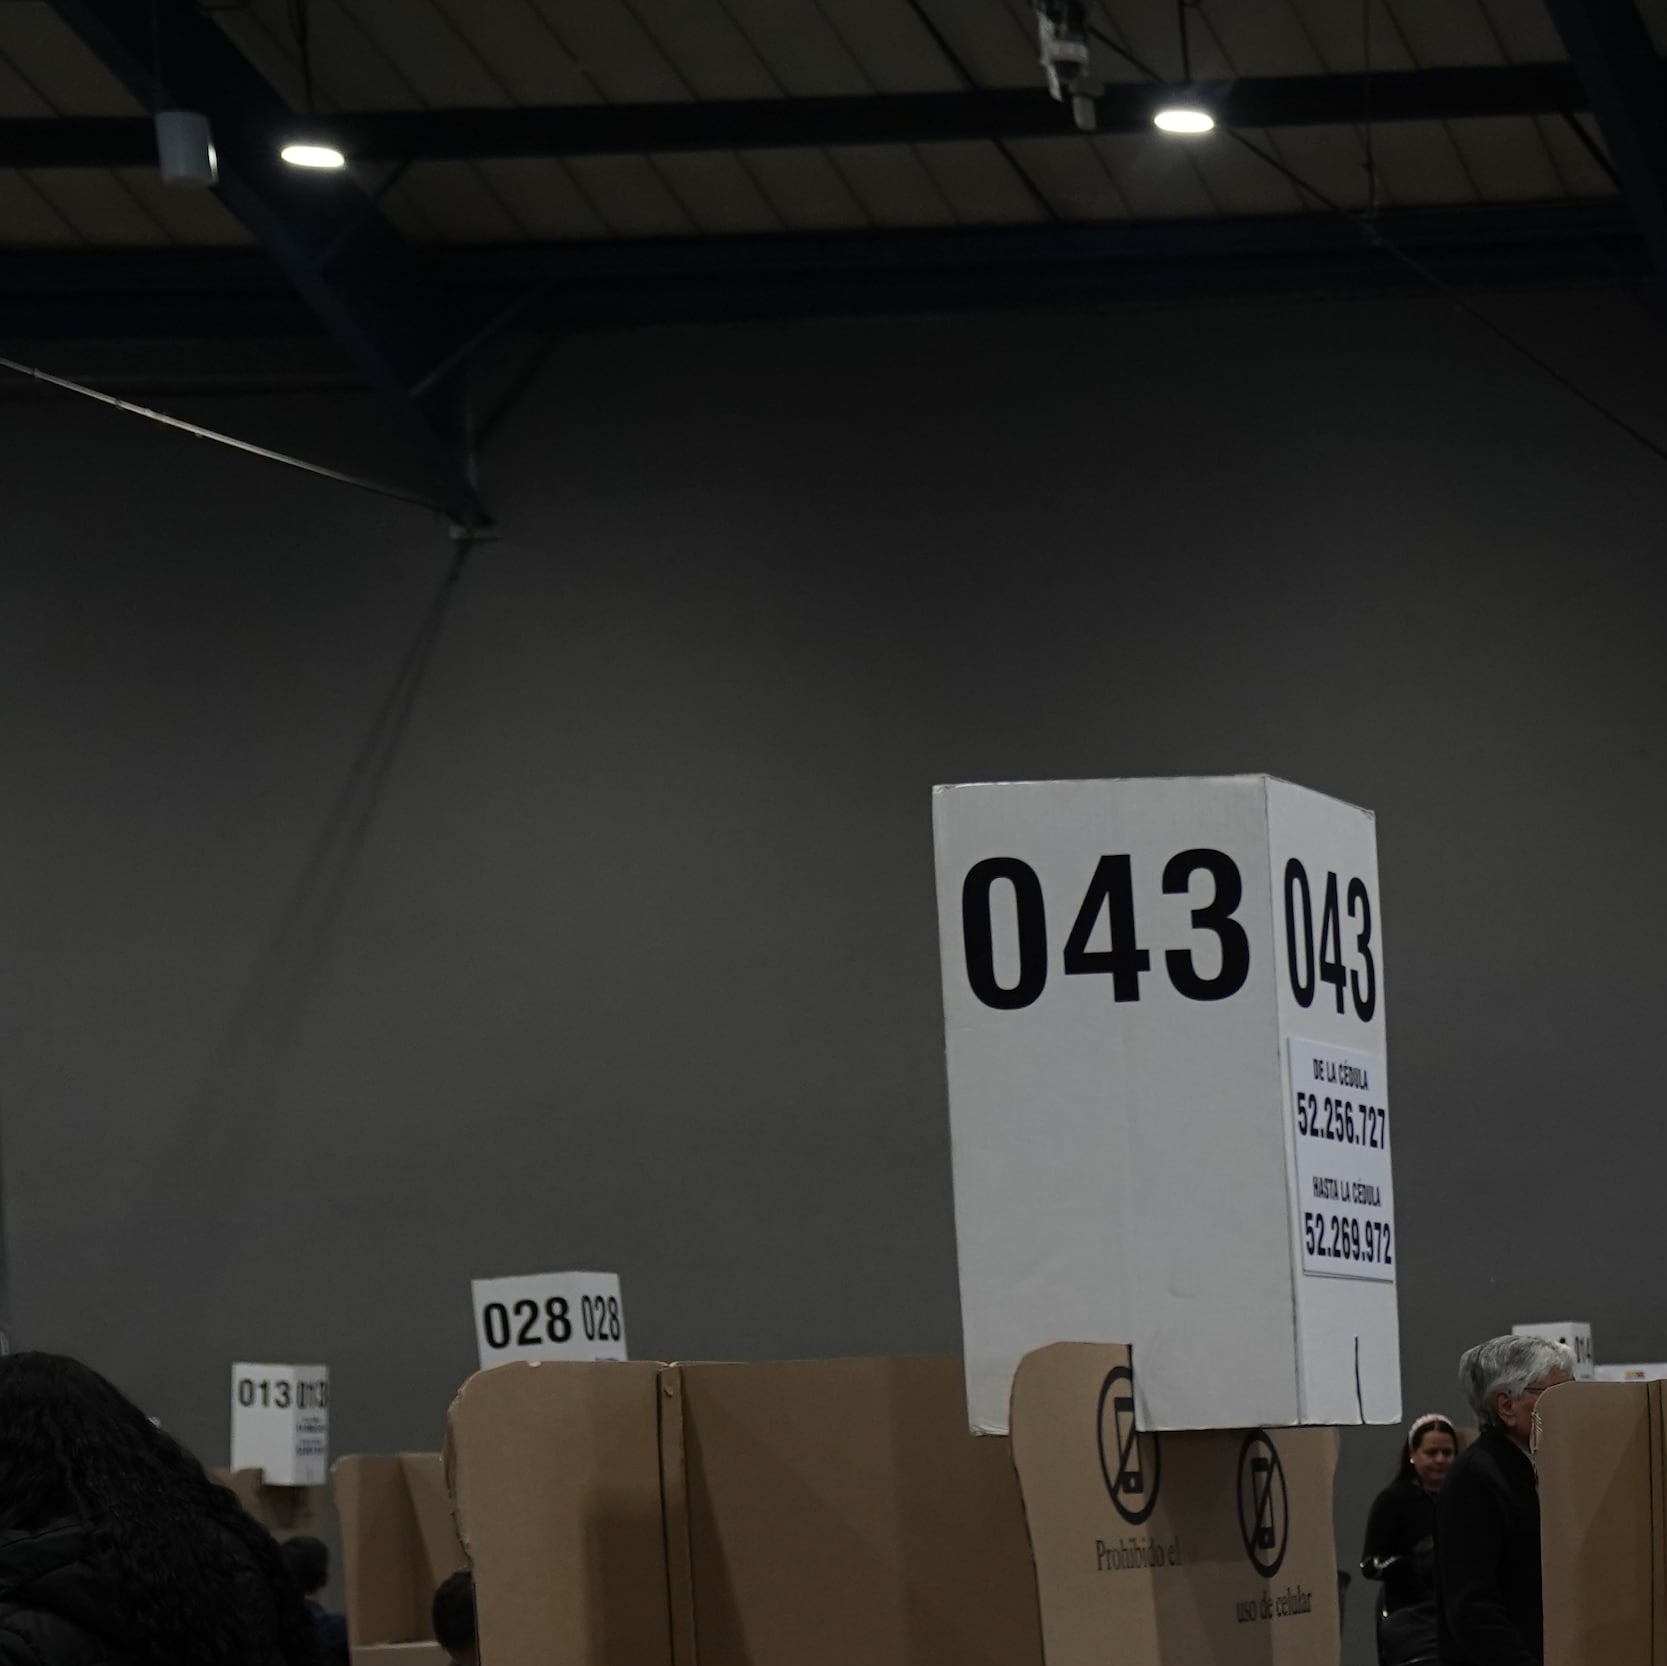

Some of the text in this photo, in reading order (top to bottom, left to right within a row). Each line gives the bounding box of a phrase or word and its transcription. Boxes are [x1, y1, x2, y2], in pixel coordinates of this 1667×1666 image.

[961, 848, 1251, 1011] 043
[1284, 857, 1377, 1023] 043
[1313, 1058, 1368, 1090] DE LA CÉDULA
[1297, 1092, 1385, 1149] 52.256.727
[1312, 1175, 1382, 1207] HASTA LA CÉDULA
[1305, 1212, 1392, 1264] 52.269.972
[484, 1297, 572, 1349] 028
[582, 1295, 620, 1341] 028
[238, 1378, 292, 1408] 013
[1096, 1535, 1182, 1571] Prohibido el
[1236, 1585, 1312, 1623] uso de celular
